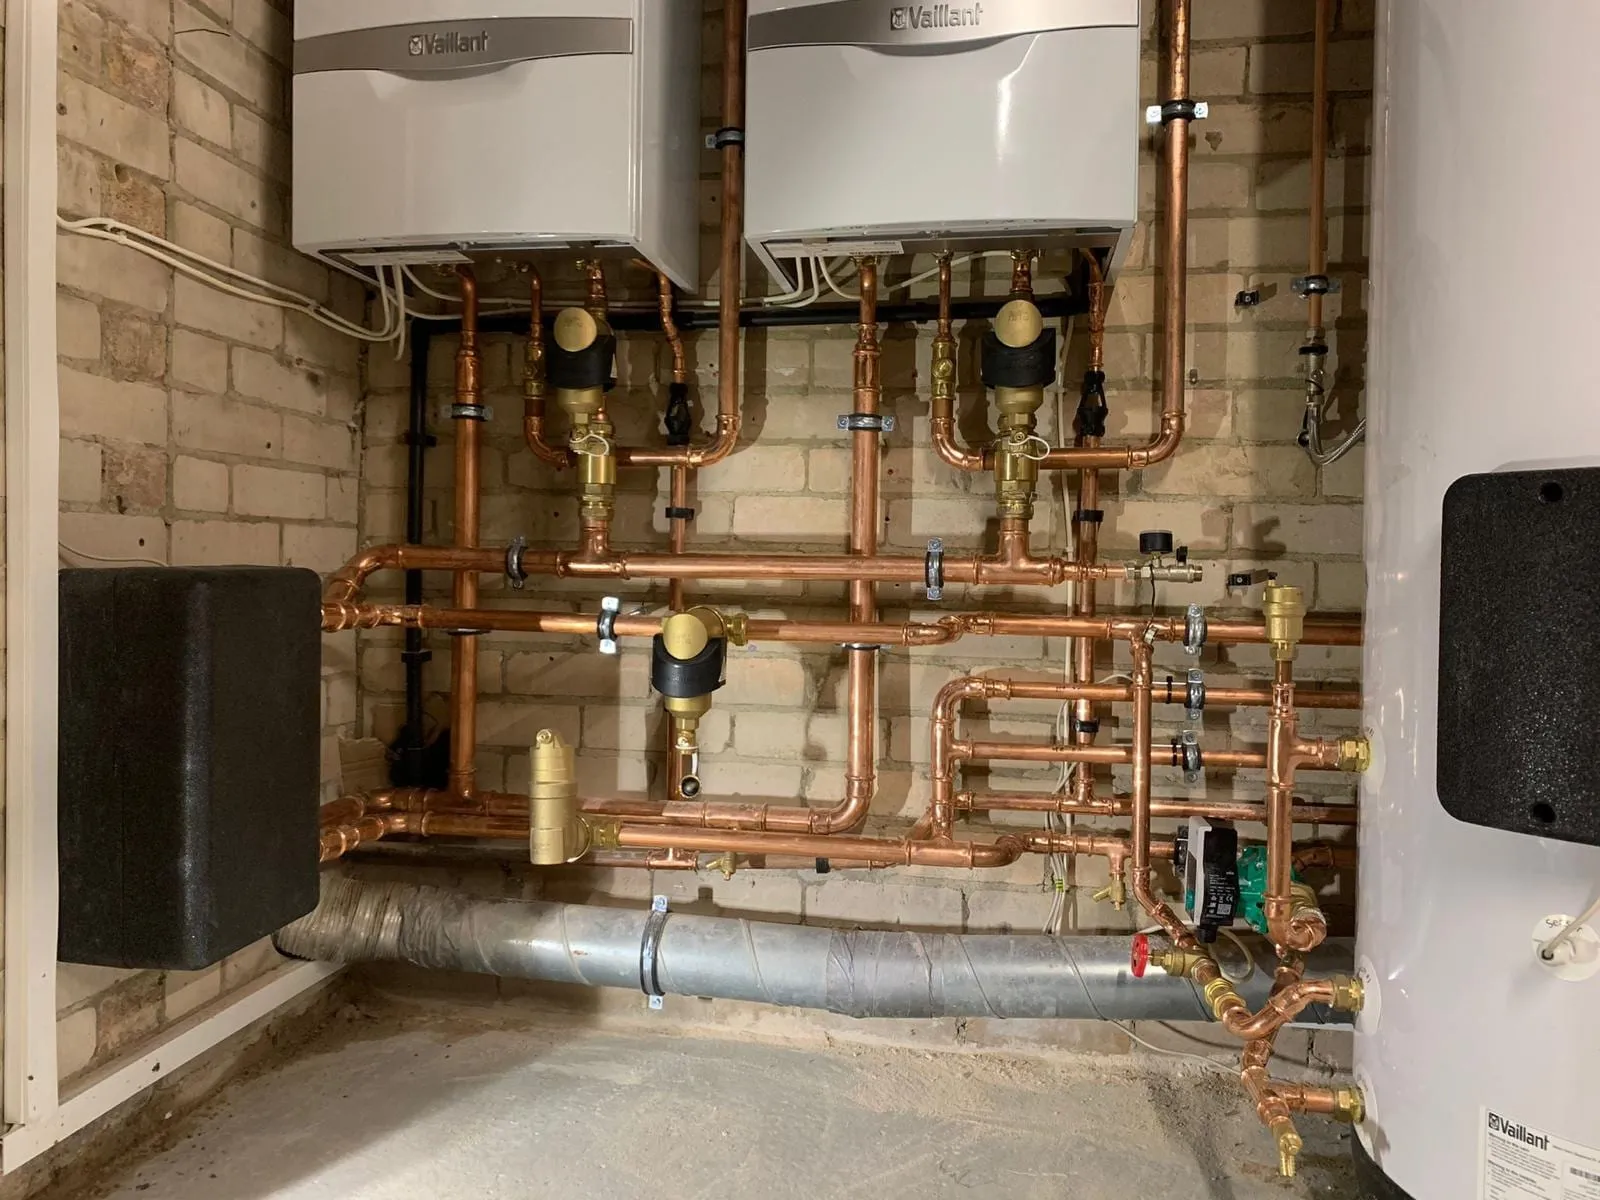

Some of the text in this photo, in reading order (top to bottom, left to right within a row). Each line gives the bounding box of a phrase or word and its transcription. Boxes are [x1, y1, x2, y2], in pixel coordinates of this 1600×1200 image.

[909, 2, 984, 30] Vaillant
[424, 30, 489, 55] Vaillant
[1500, 1117, 1550, 1151] Vaillant
